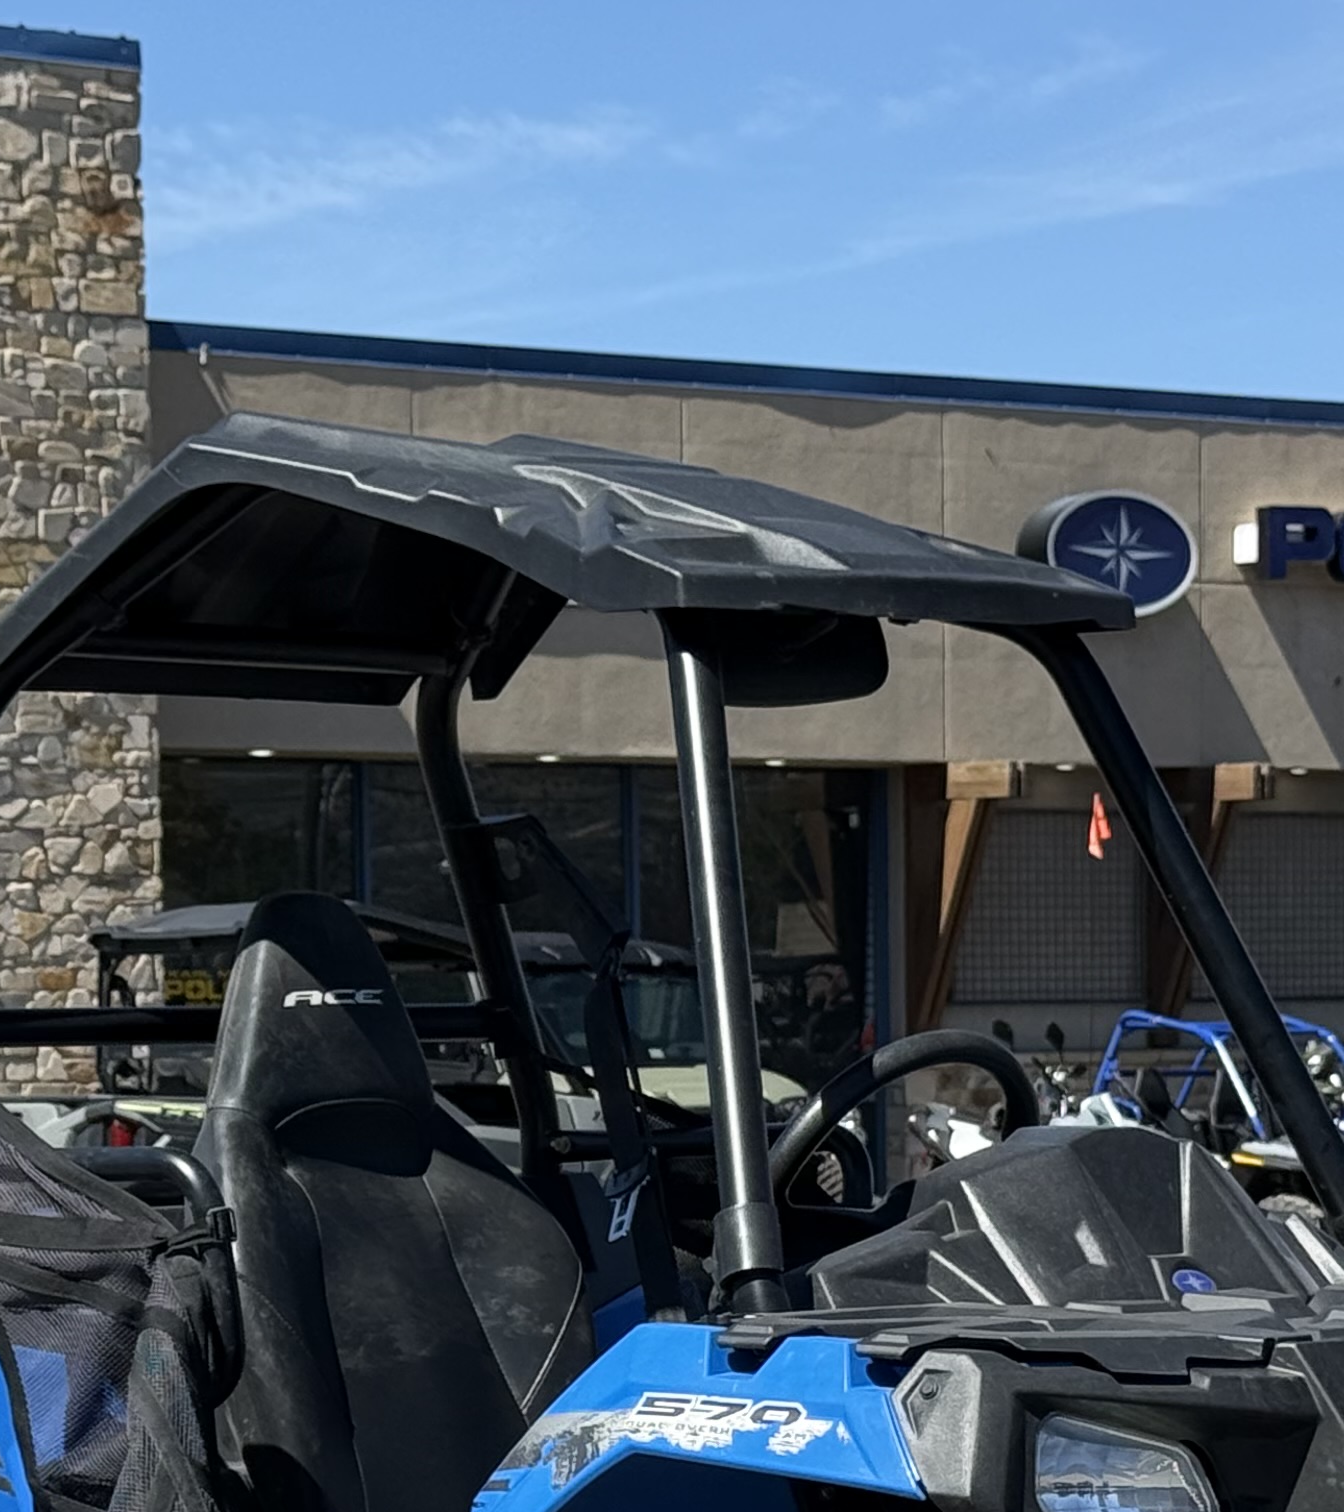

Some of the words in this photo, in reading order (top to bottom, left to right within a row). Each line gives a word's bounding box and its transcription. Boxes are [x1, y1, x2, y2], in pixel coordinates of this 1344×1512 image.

[165, 979, 224, 1001] POL
[283, 988, 384, 1008] ACE
[635, 1396, 803, 1426] 570
